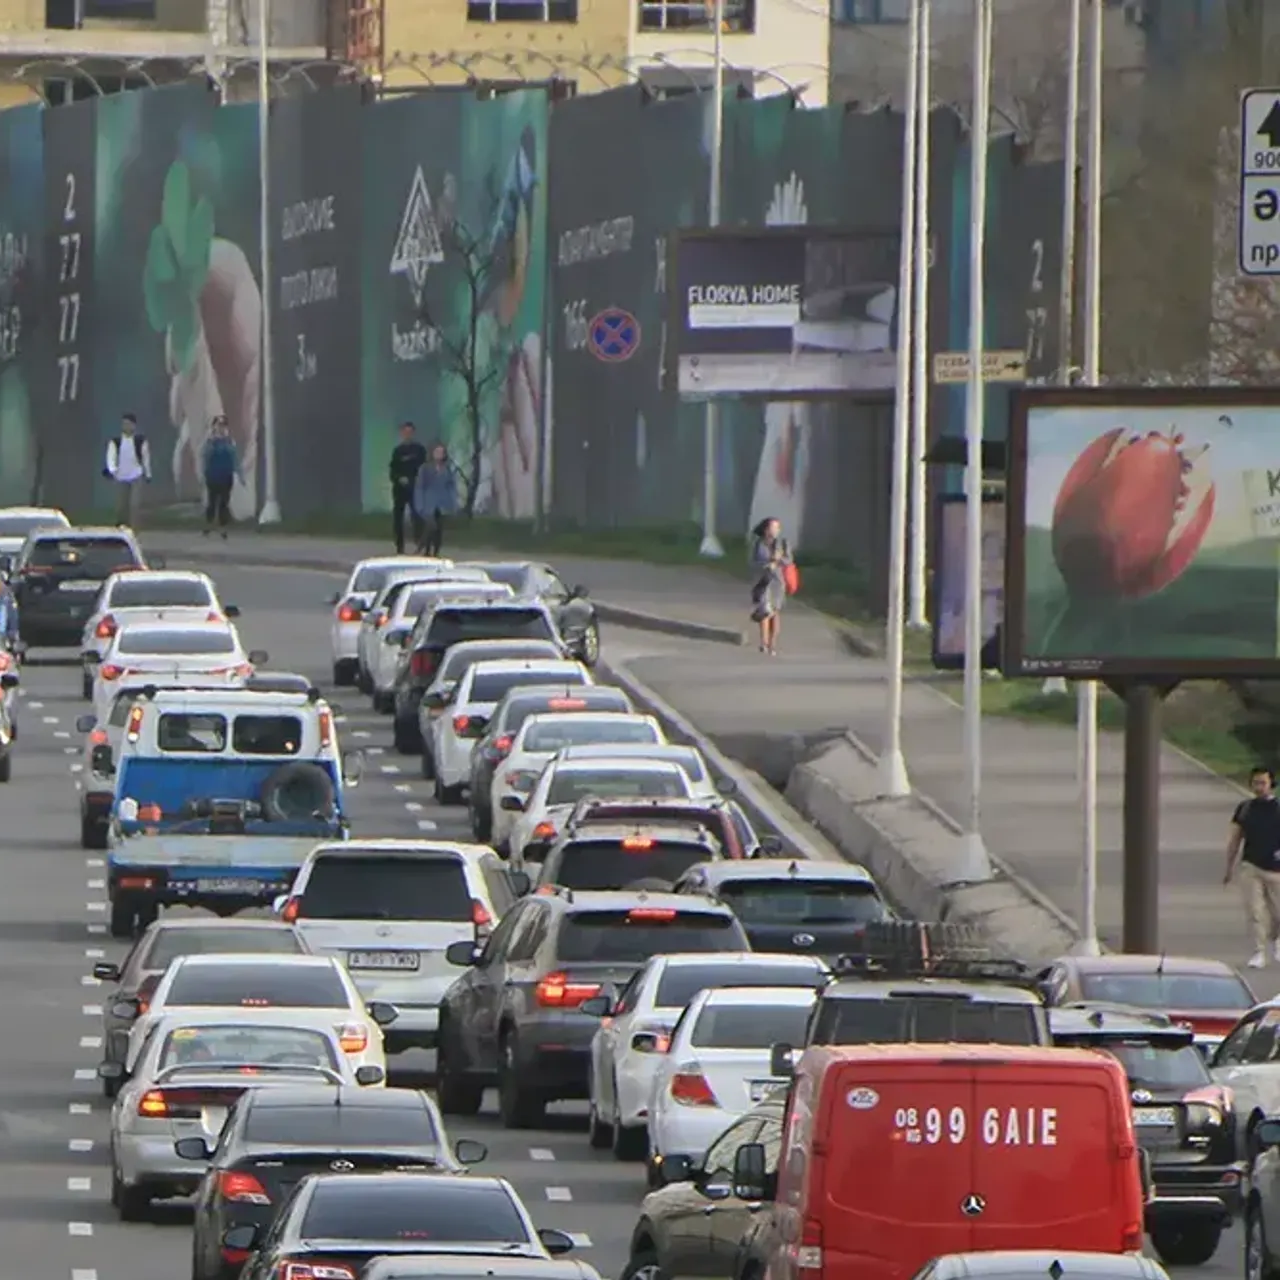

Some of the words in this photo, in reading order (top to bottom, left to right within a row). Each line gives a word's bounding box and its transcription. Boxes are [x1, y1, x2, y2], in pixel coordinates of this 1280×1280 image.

[689, 285, 748, 304] FLORYA
[752, 285, 800, 303] HOME
[895, 1108, 918, 1127] 08
[925, 1107, 966, 1144] 99
[982, 1107, 1057, 1145] 6AIE
